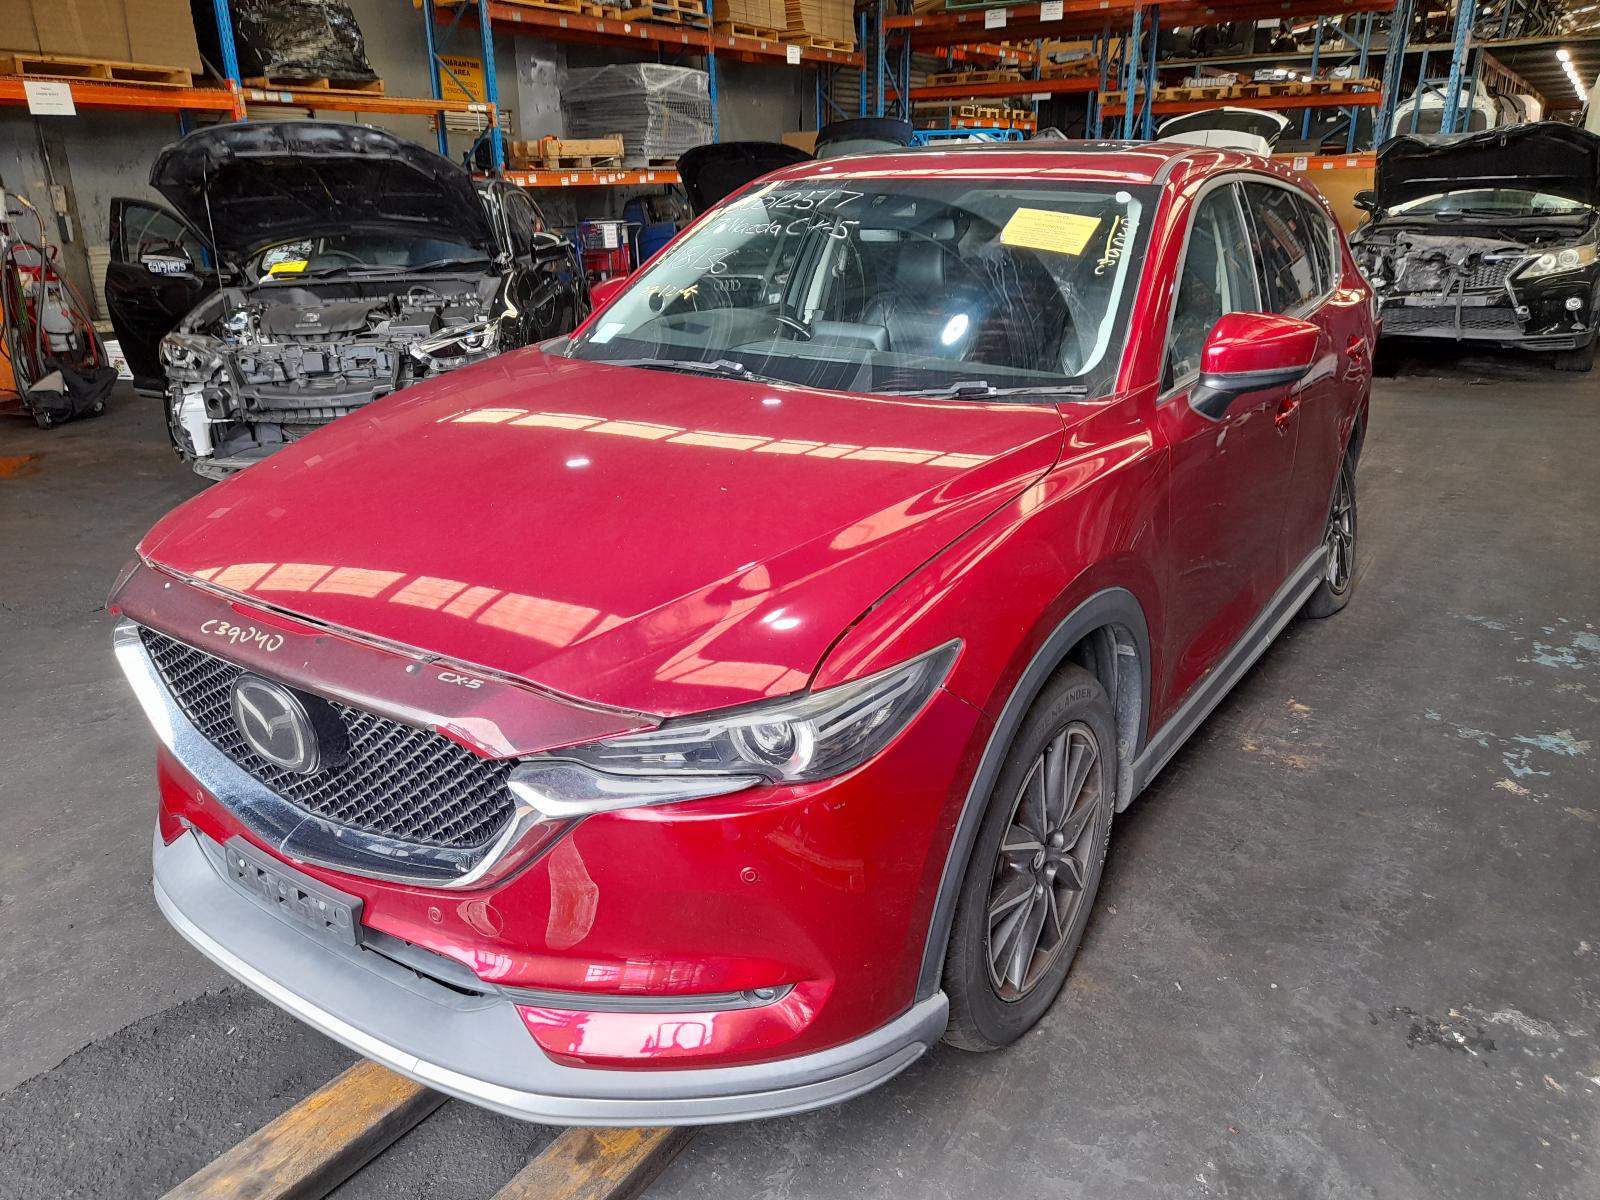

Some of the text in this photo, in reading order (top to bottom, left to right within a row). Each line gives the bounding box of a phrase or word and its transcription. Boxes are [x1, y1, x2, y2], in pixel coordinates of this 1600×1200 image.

[453, 68, 471, 77] AREA
[200, 619, 284, 652] C39040
[437, 671, 485, 689] CX-5
